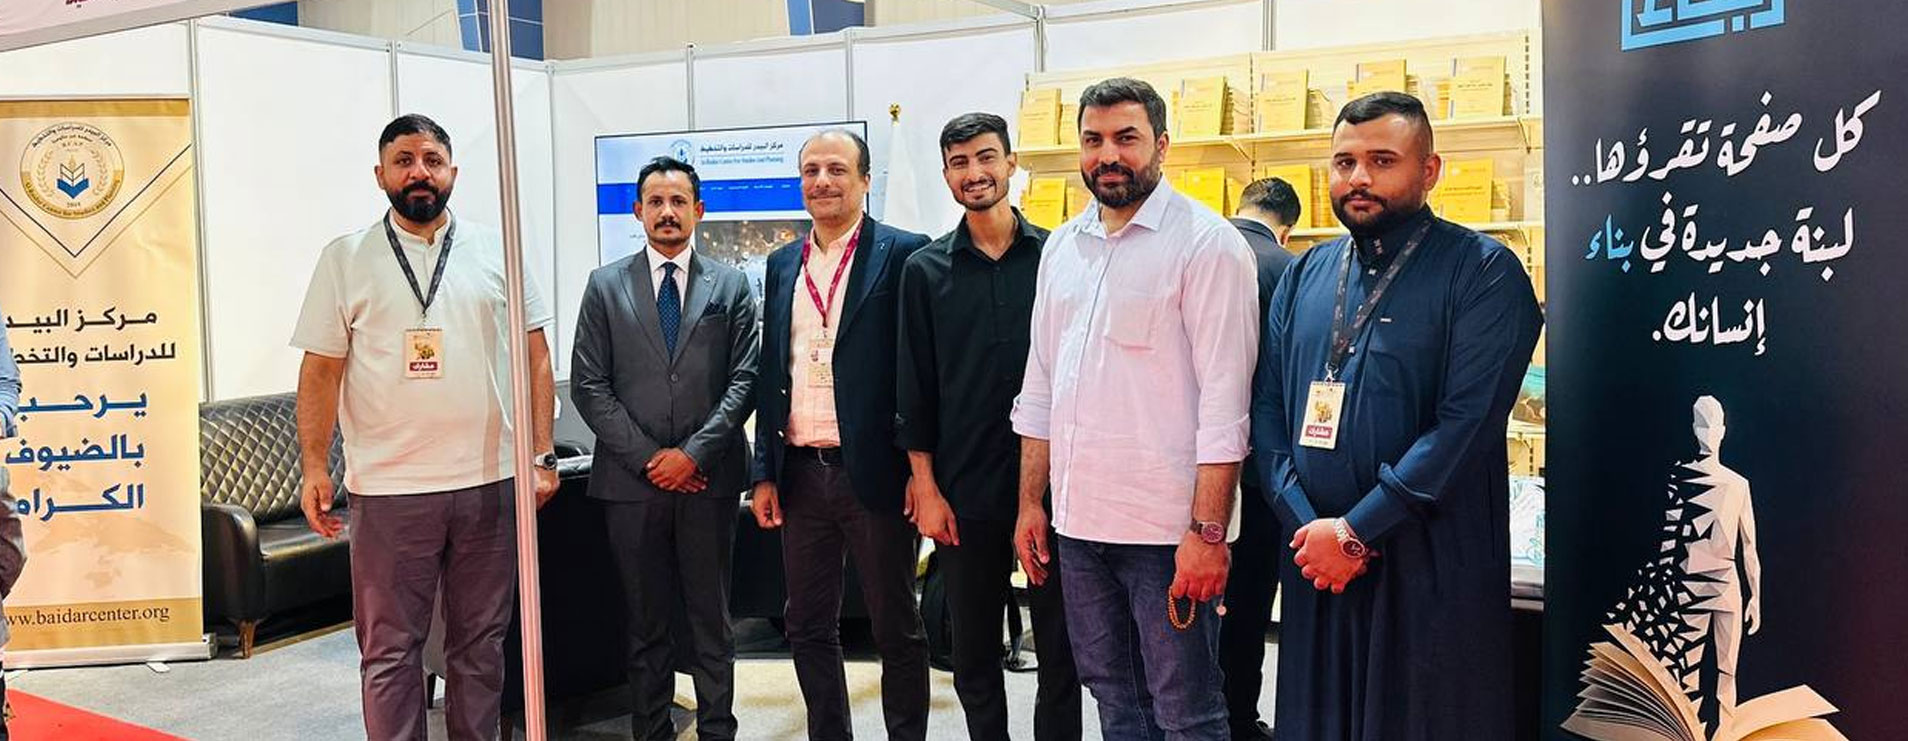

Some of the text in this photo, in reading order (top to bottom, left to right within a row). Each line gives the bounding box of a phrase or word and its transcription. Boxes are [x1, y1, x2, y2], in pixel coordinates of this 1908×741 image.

[1571, 90, 1881, 184] كل صفحة تقرؤها..
[1585, 191, 1854, 281] لبنة جديدة في بناء
[5, 306, 158, 334] مركز البيد
[1652, 292, 1767, 356] إنسانك.
[85, 342, 176, 365] للدراسات
[18, 392, 147, 419] يرحب
[5, 434, 144, 471] بالضيوف
[5, 607, 170, 626] ww.baidarcenter.org
